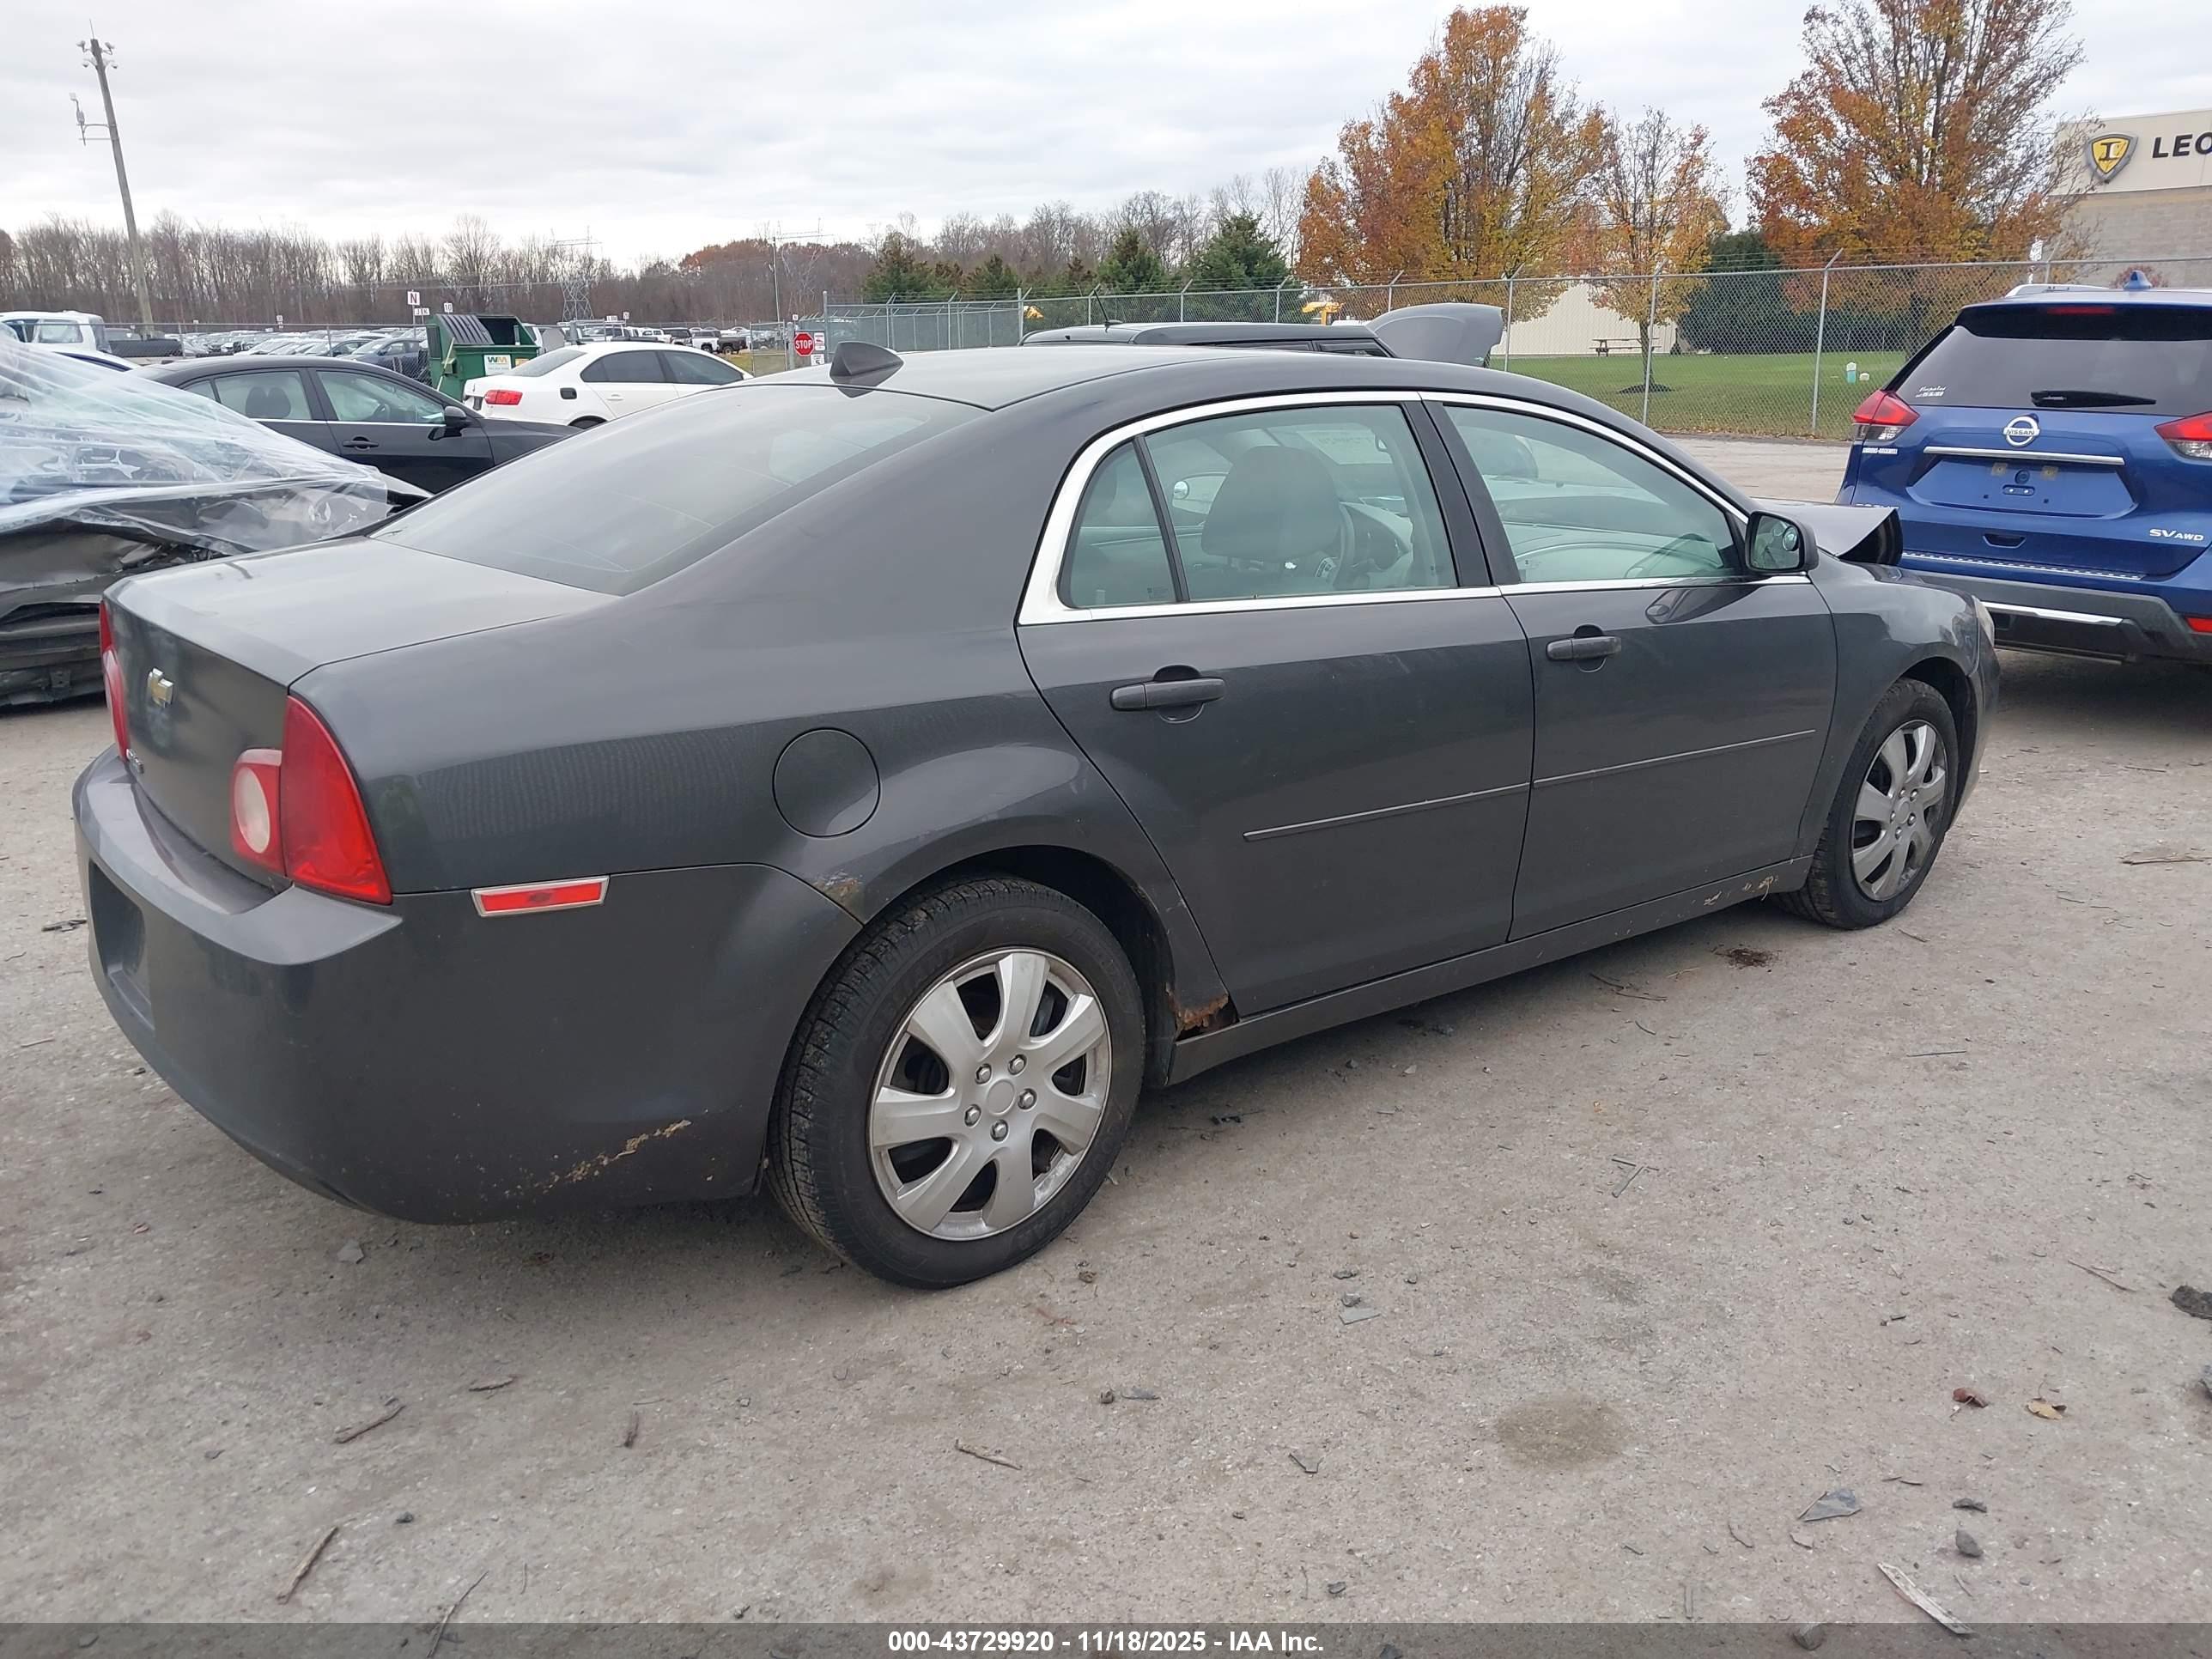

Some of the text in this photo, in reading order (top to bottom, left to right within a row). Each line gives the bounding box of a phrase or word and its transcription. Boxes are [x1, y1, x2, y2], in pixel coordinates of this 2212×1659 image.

[410, 293, 417, 304] N
[795, 339, 813, 349] STOP
[2149, 528, 2204, 541] SV AWD
